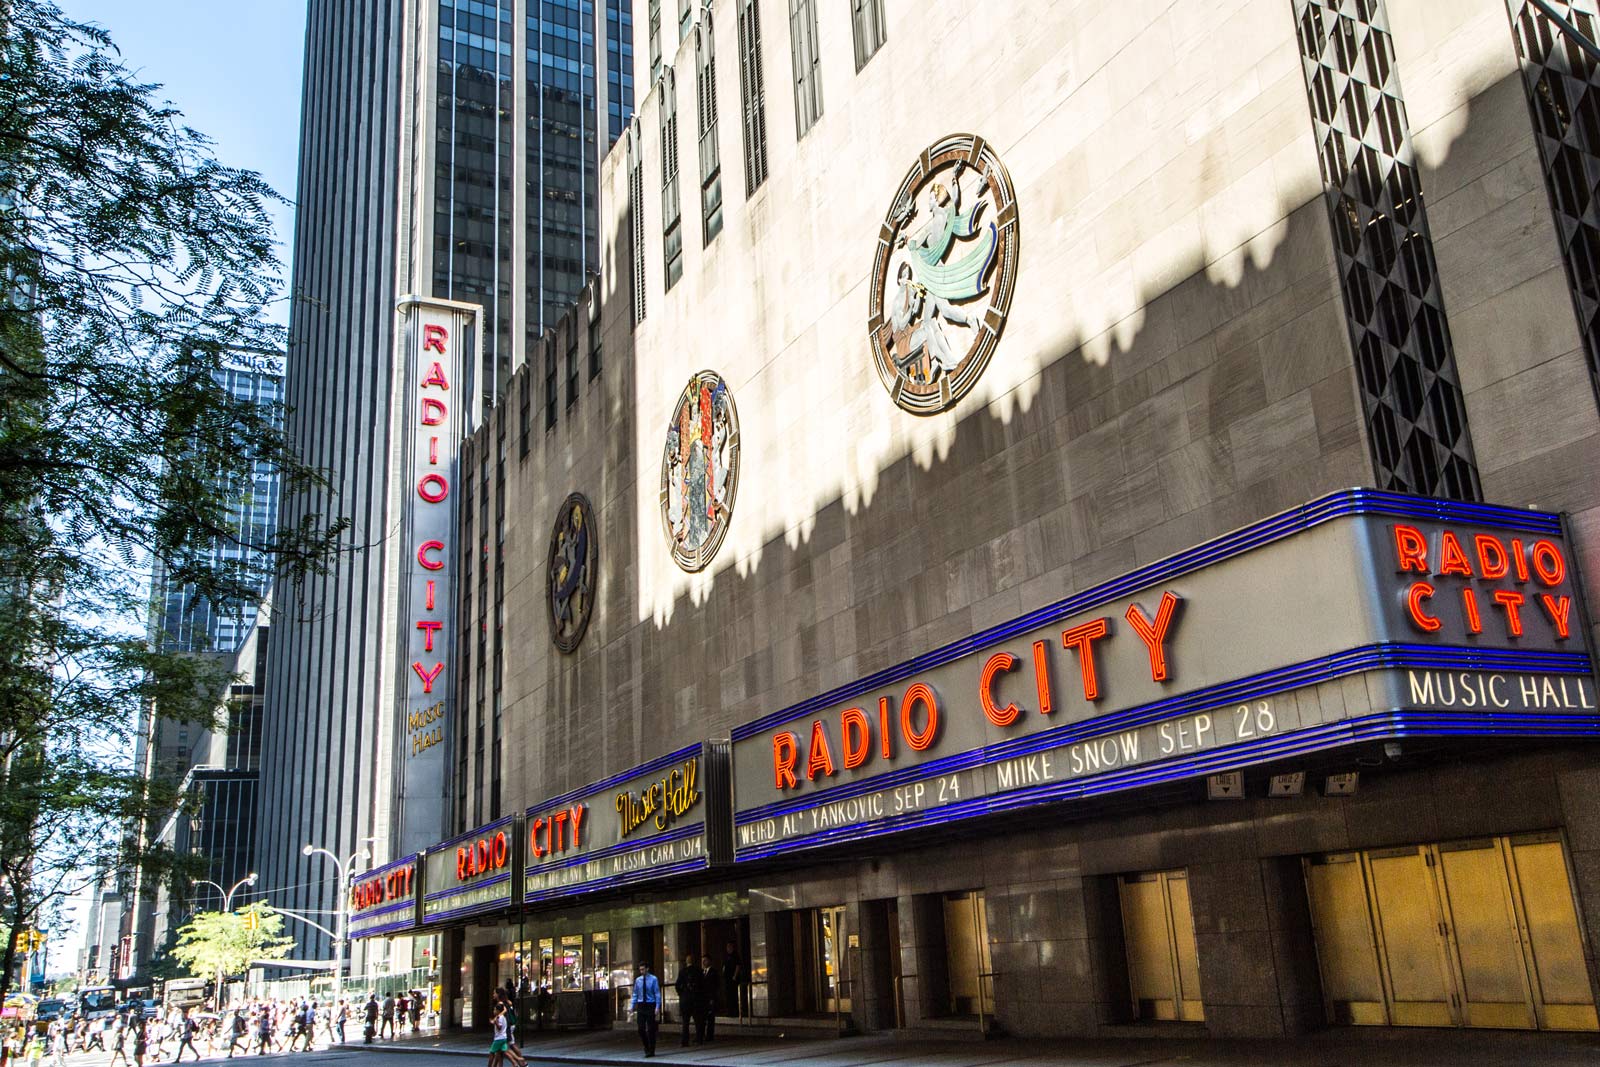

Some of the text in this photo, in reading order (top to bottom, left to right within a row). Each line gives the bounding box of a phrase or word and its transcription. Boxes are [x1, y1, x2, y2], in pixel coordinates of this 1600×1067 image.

[412, 324, 450, 693] RADIO CITY
[1394, 525, 1566, 586] RADIO
[1408, 582, 1570, 638] CITY
[773, 590, 1180, 790] RADIO CITY
[1409, 671, 1596, 709] MUSIC HALL
[408, 702, 445, 735] MUSIC
[412, 726, 443, 757] HALL
[997, 701, 1275, 788] MIIKE SNOW SEP 28
[615, 757, 698, 838] Music Hall
[741, 819, 776, 845] WEIRD
[811, 793, 883, 829] YANKOVIC
[895, 783, 925, 812] SEP
[938, 775, 960, 803] 24
[457, 831, 506, 880] RADIO
[531, 802, 583, 858] CITY
[613, 850, 647, 873] ALESSIA
[650, 843, 675, 865] CARA
[386, 865, 413, 902] CITY
